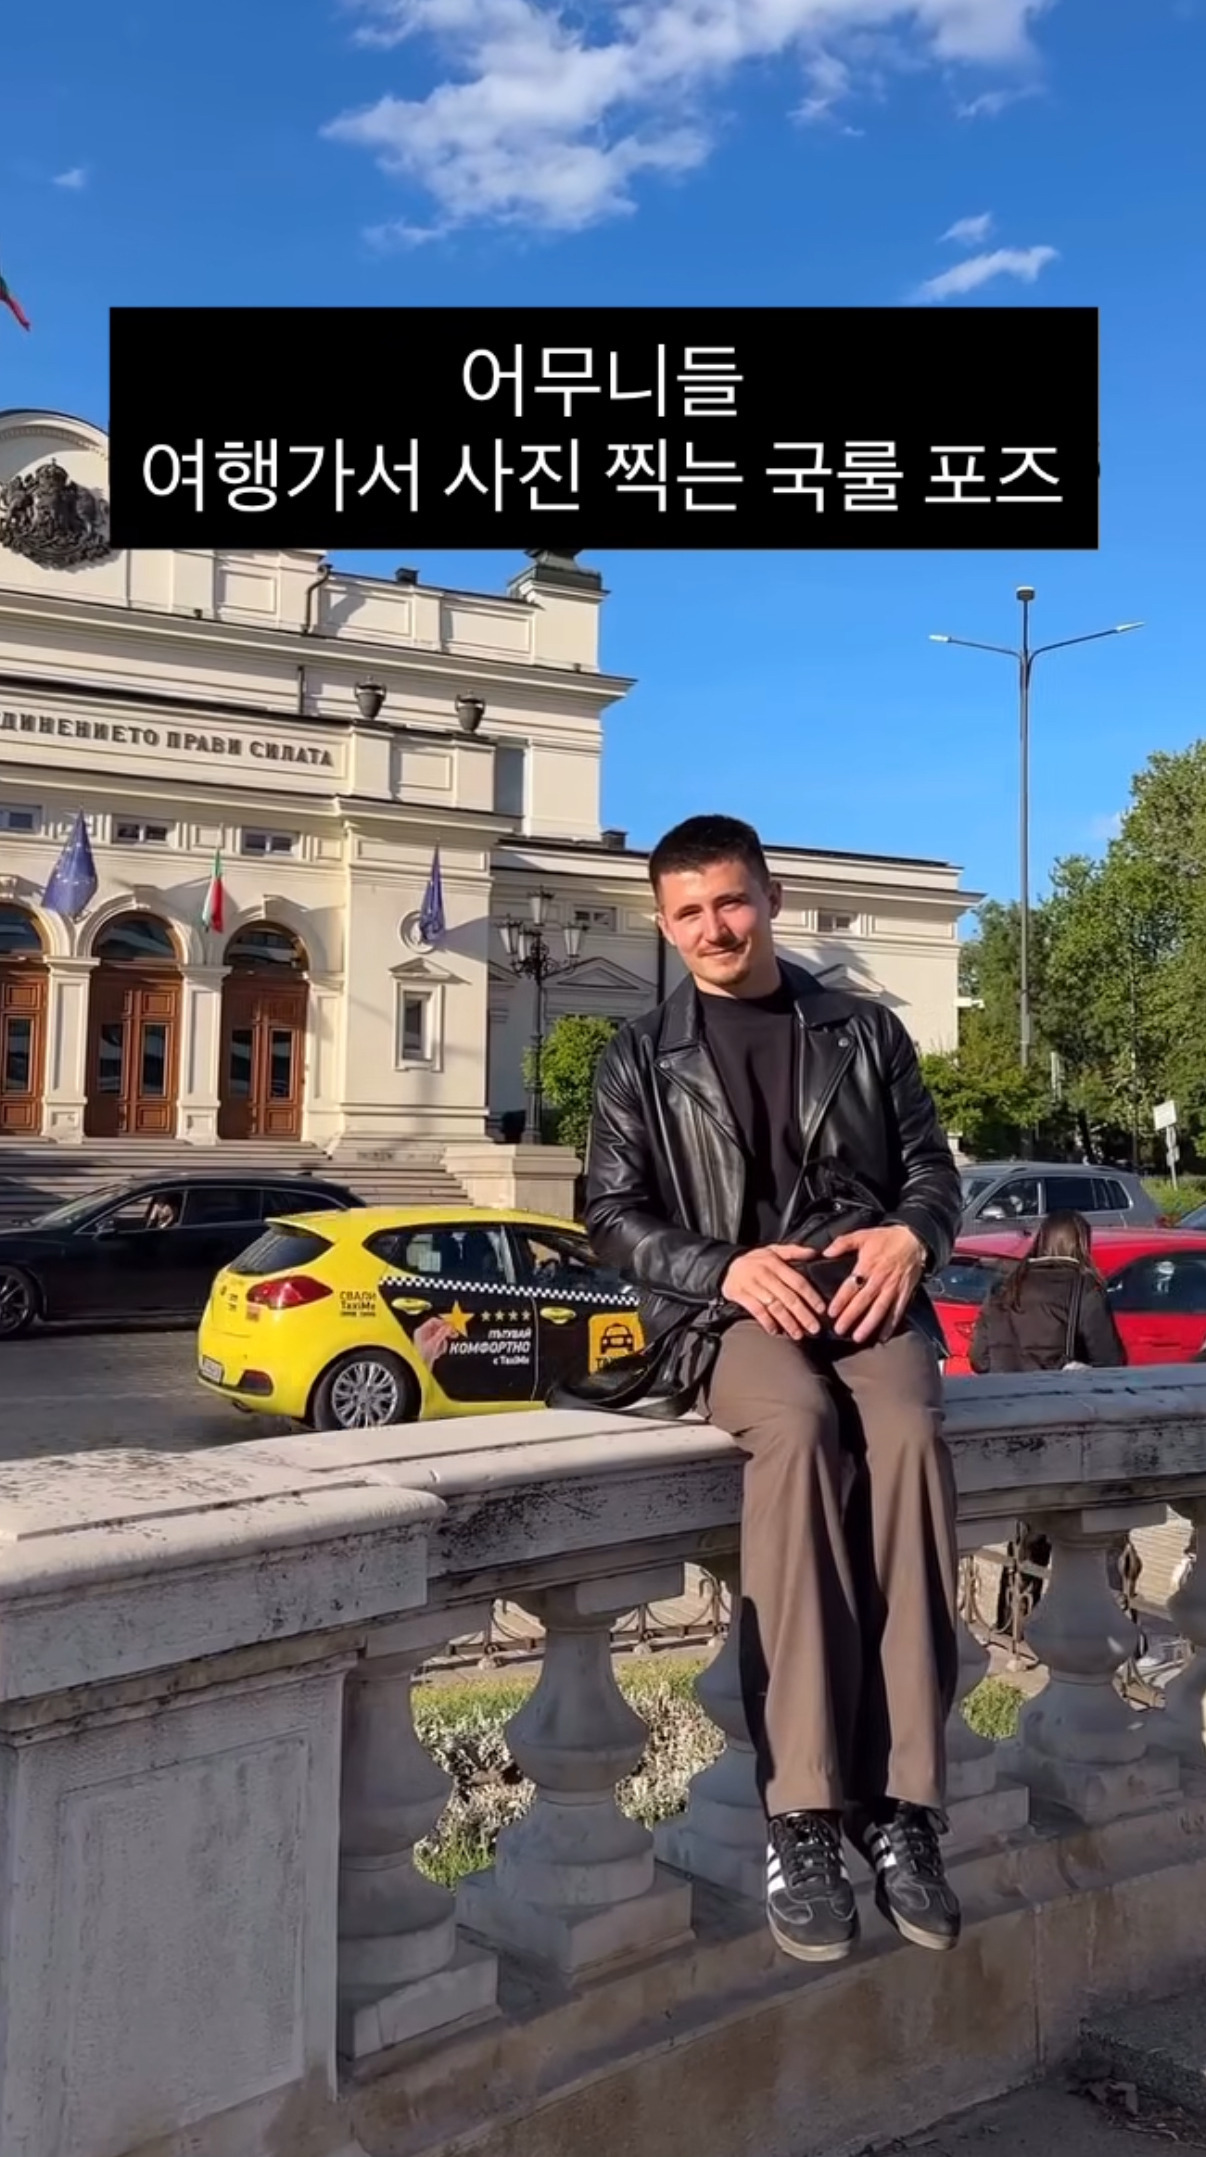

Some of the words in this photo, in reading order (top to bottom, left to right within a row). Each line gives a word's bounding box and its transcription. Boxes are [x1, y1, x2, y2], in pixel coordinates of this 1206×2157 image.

[0, 711, 160, 746] ДИНЕНИЕТО
[166, 731, 242, 756] ПРАВИ
[249, 741, 334, 767] СИЛАТА
[449, 1341, 531, 1355] КОМФОРТНО
